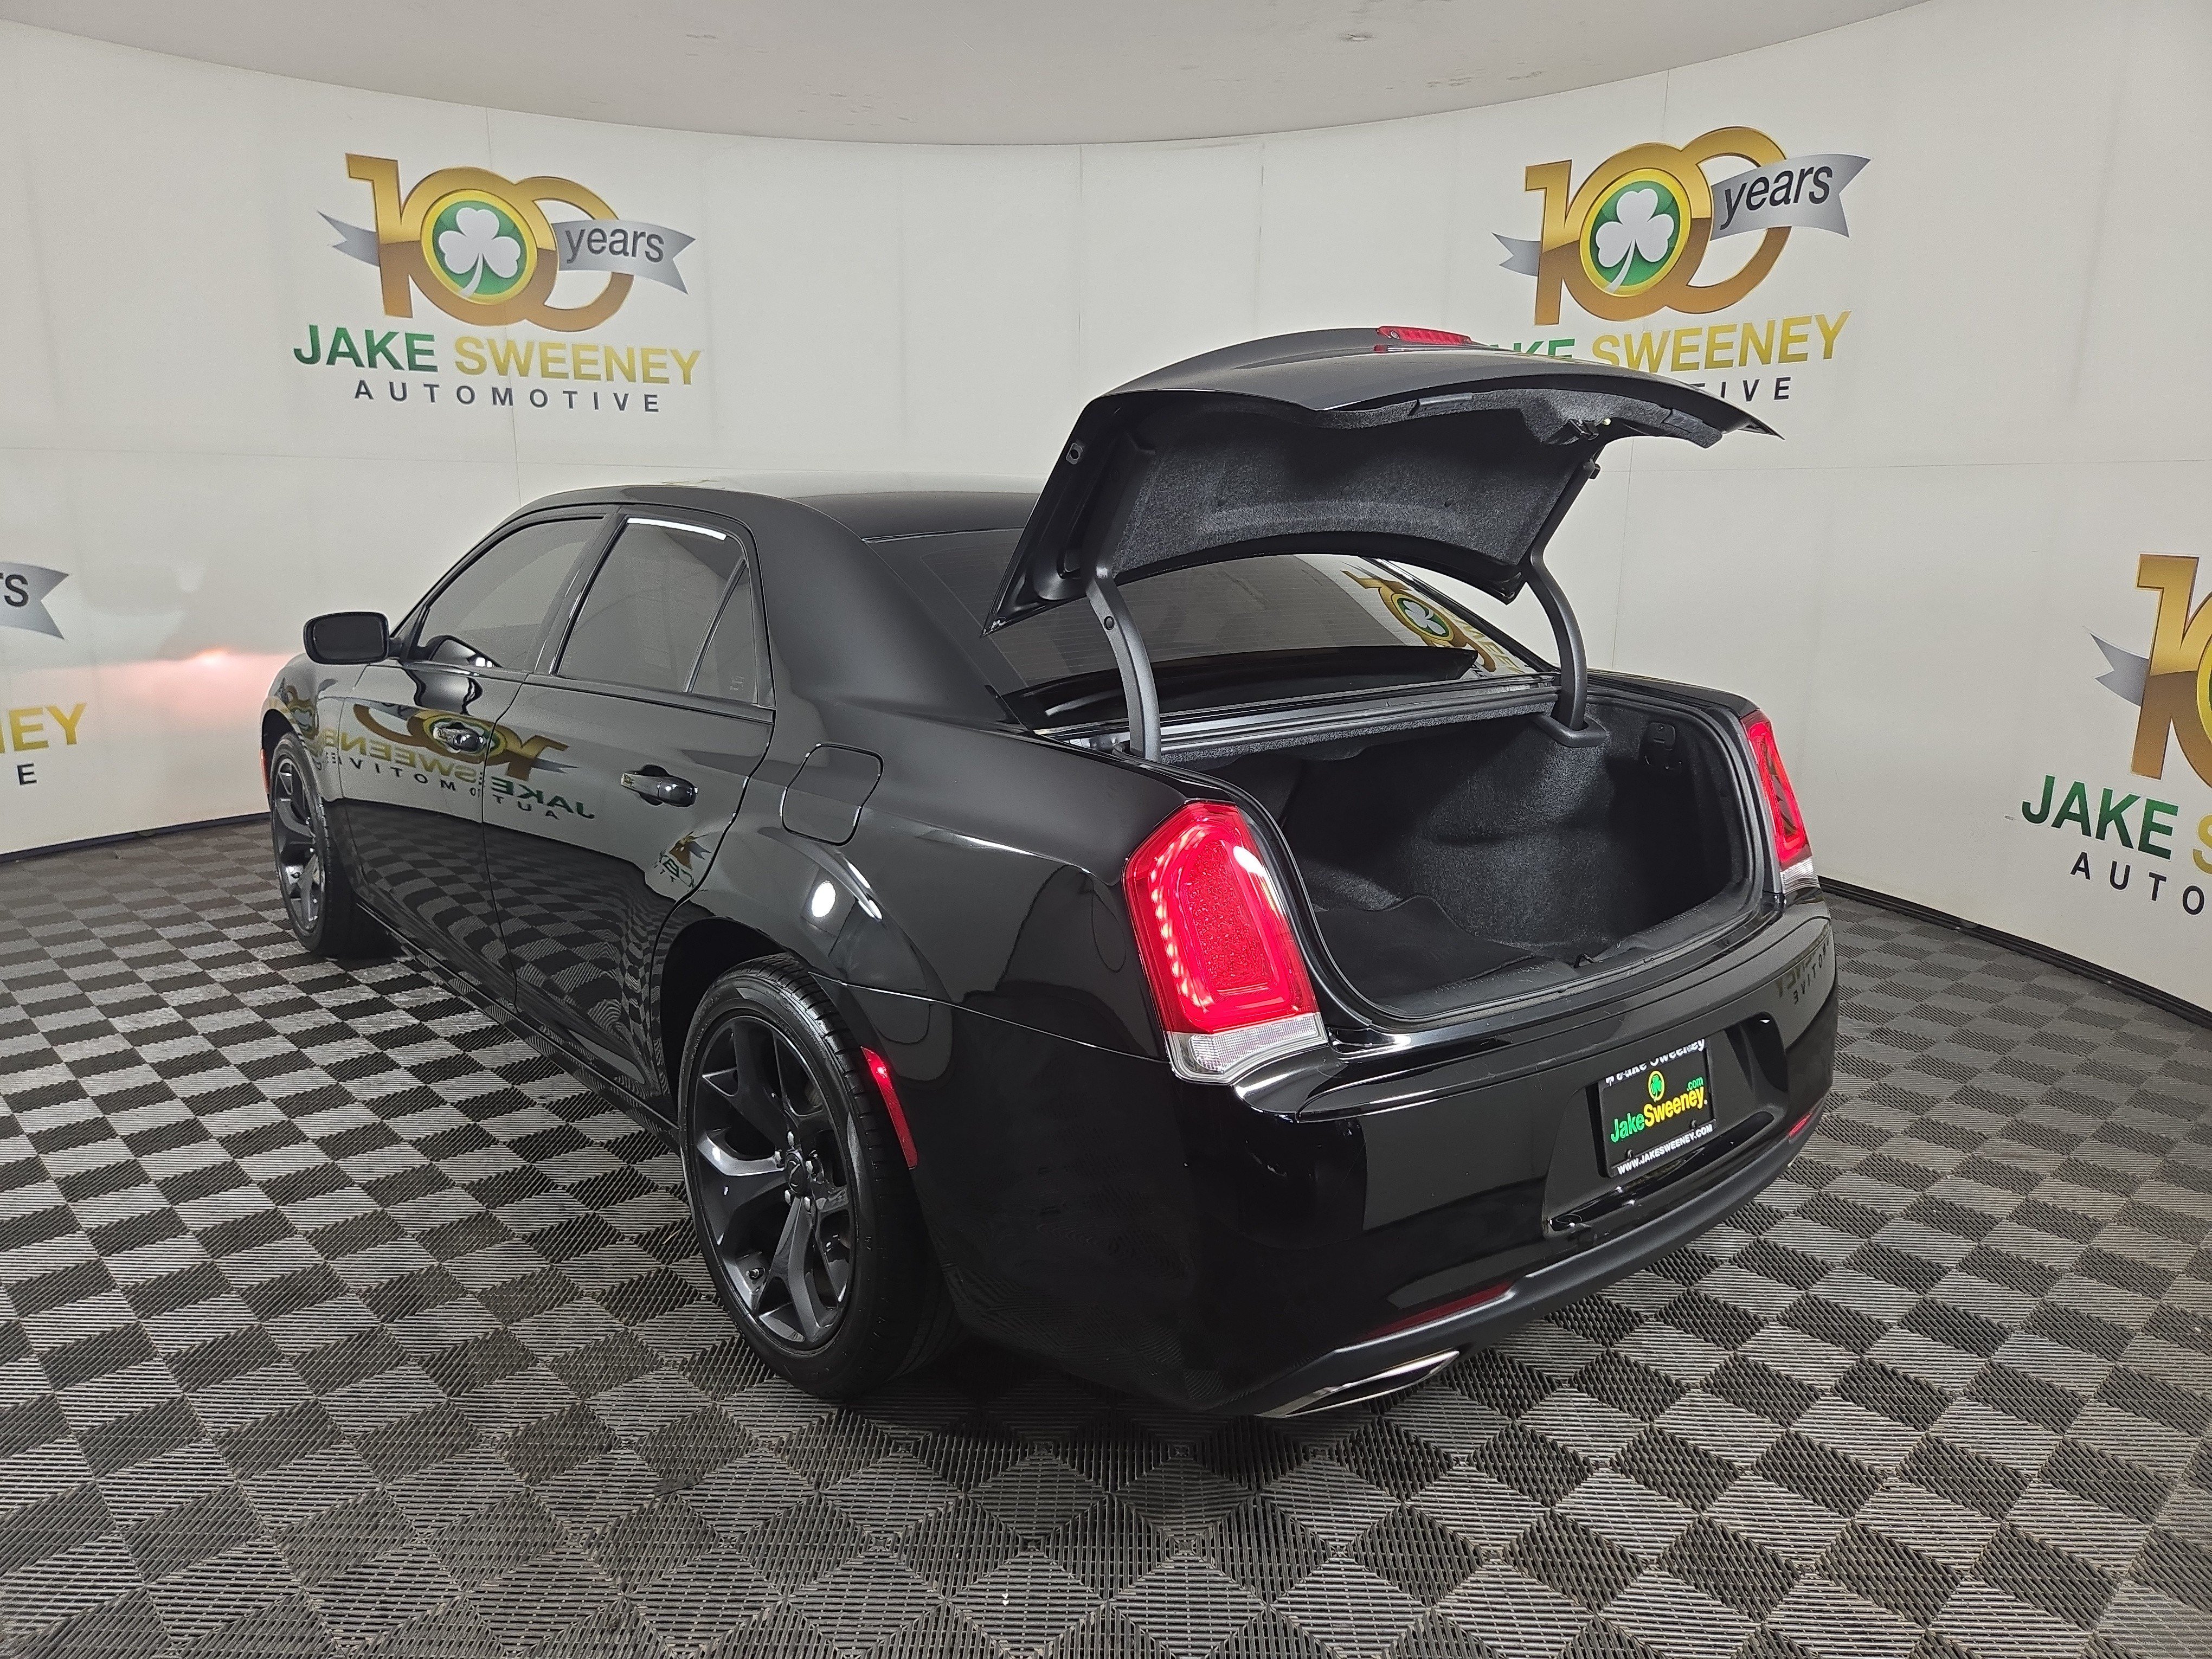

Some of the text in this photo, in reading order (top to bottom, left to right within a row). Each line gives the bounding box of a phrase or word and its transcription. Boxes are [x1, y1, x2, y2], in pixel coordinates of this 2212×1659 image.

[1719, 164, 1833, 230] years
[565, 226, 665, 264] years
[293, 324, 702, 386] JAKE SWEENEY
[1591, 310, 1852, 374] SWEENEY
[353, 380, 660, 413] AUTOMOTIVE
[2021, 774, 2179, 861] JAKE
[2069, 851, 2205, 915] AUTO
[1617, 1123, 1713, 1175] WWW.JAKESWEENEY.COM
